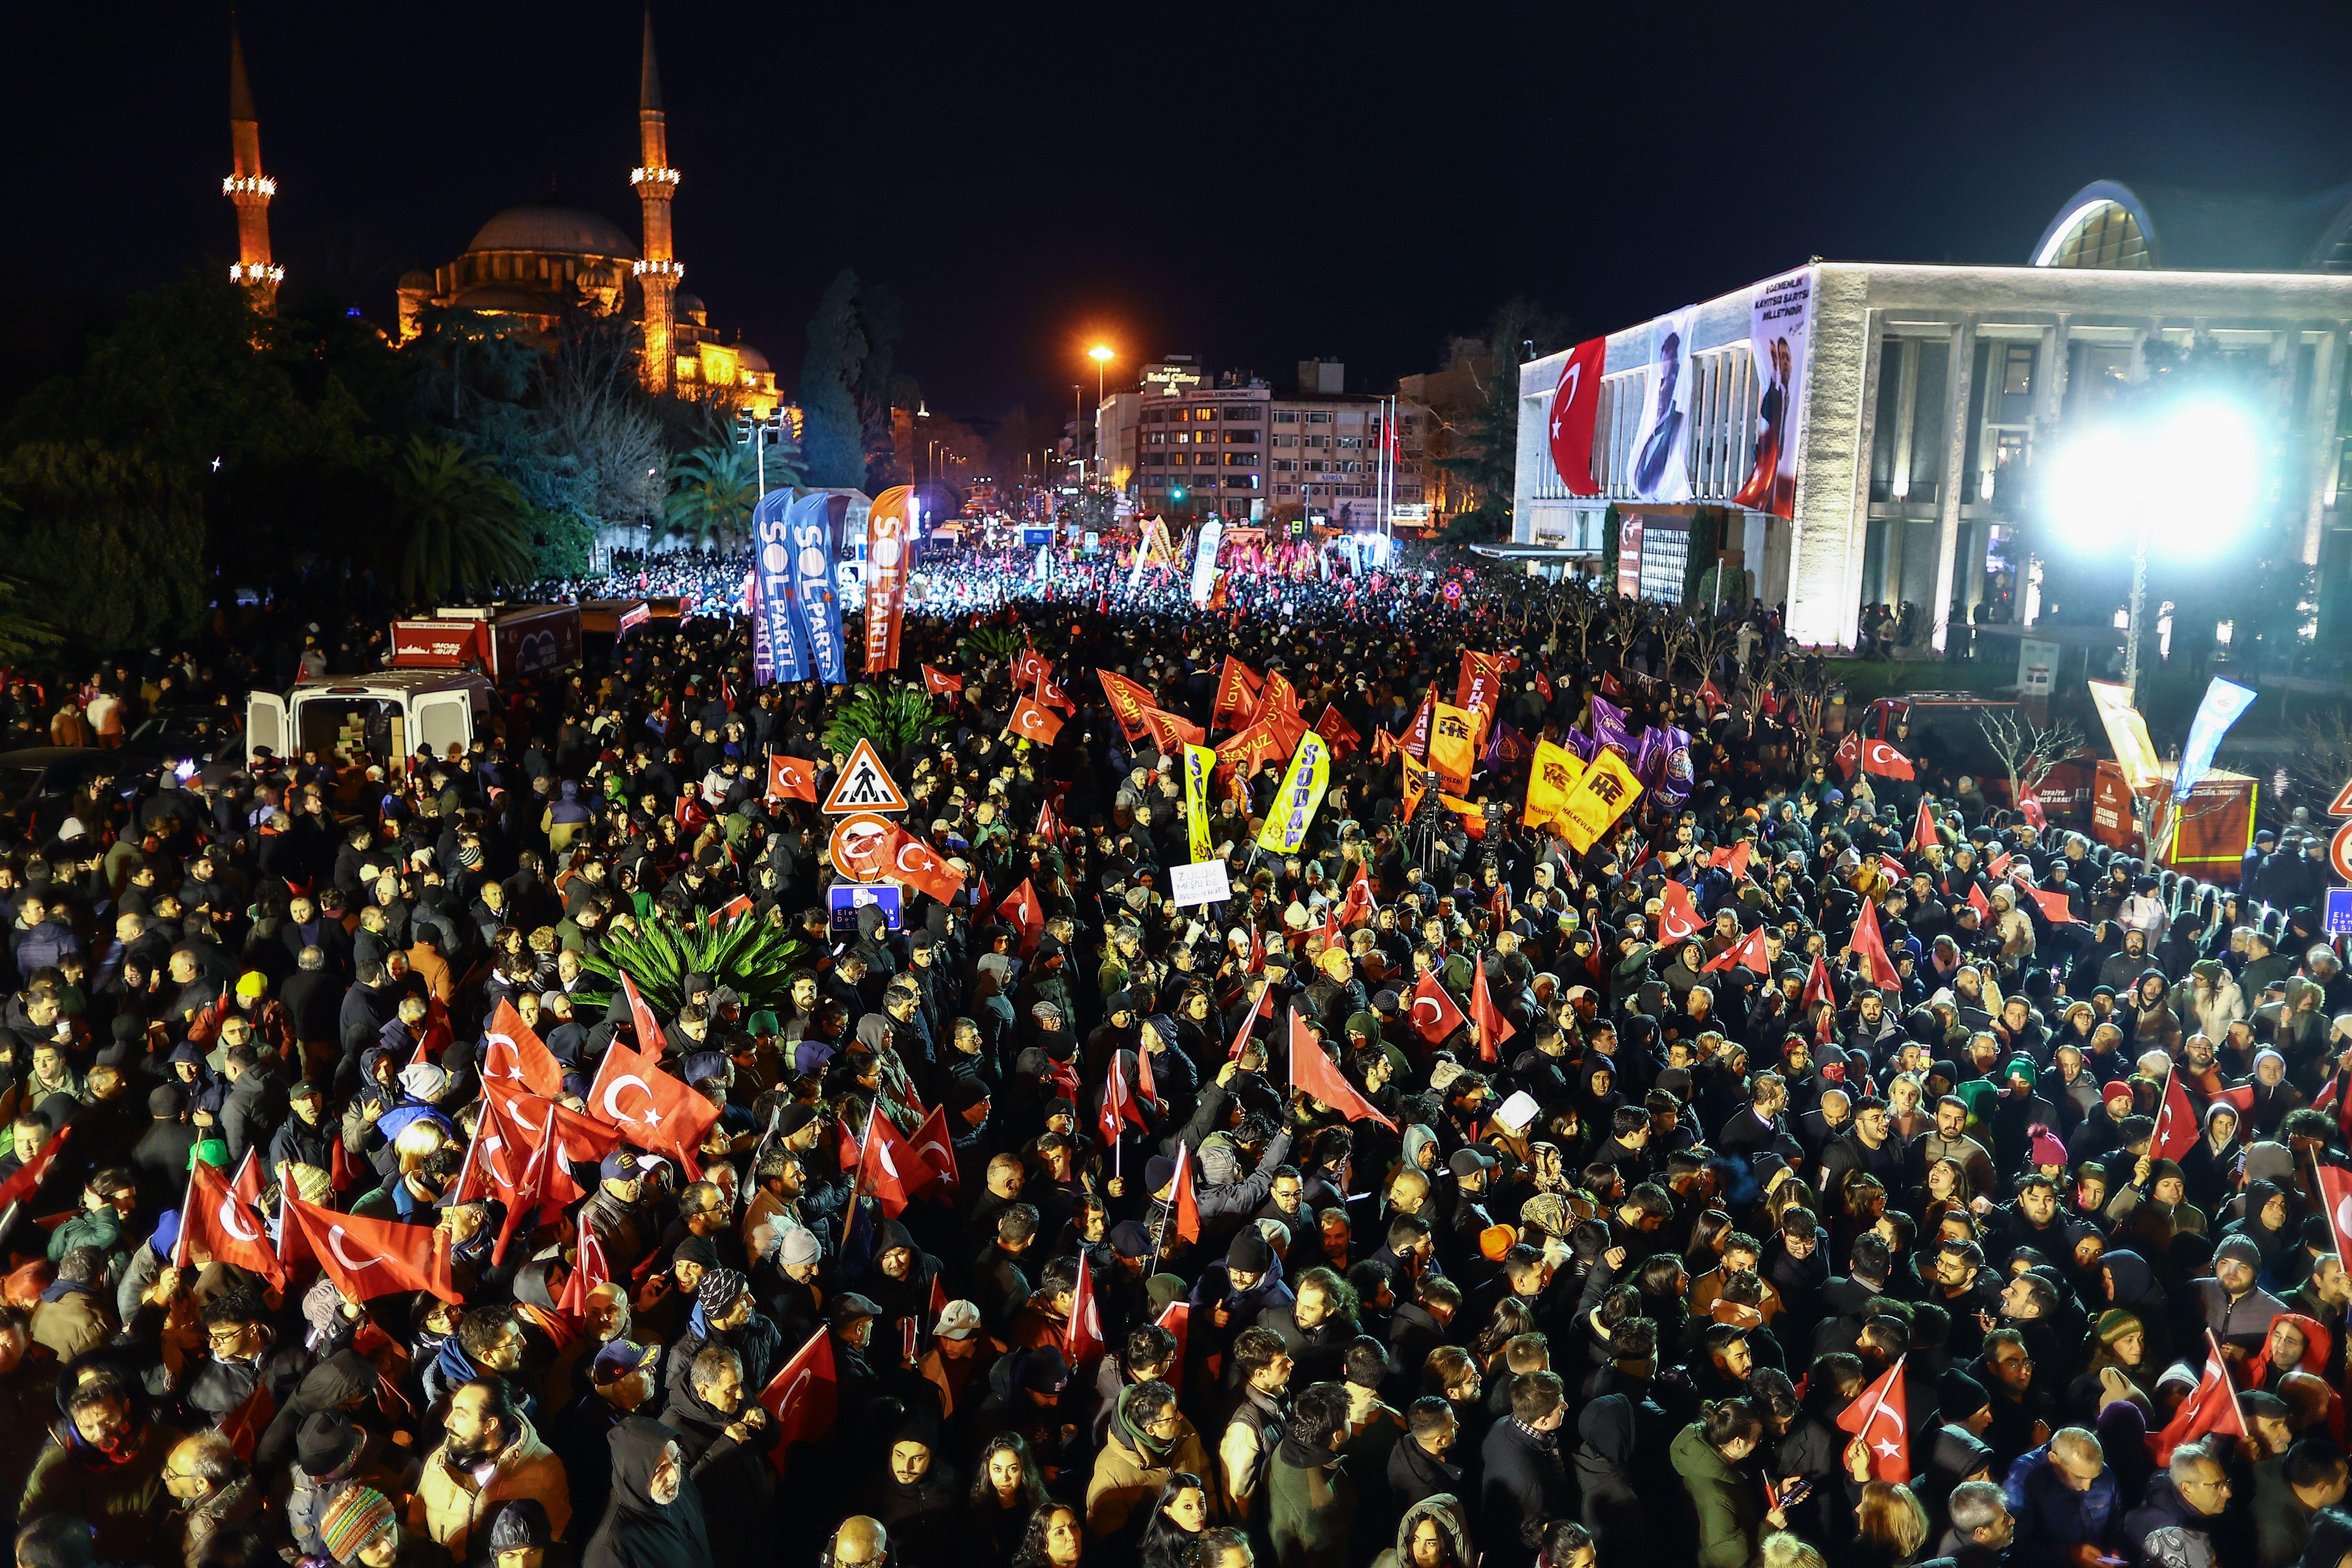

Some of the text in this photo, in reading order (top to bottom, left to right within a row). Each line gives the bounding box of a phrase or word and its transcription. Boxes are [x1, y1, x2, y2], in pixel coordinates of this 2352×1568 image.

[759, 520, 791, 596] SOL
[793, 525, 829, 601] SOL
[871, 514, 900, 588] SOL
[1285, 744, 1319, 848] SODAP
[1441, 775, 1463, 785] KEVLERİ
[1529, 803, 1554, 817] HALKEVL
[1562, 807, 1598, 836] HALKEVLERİ
